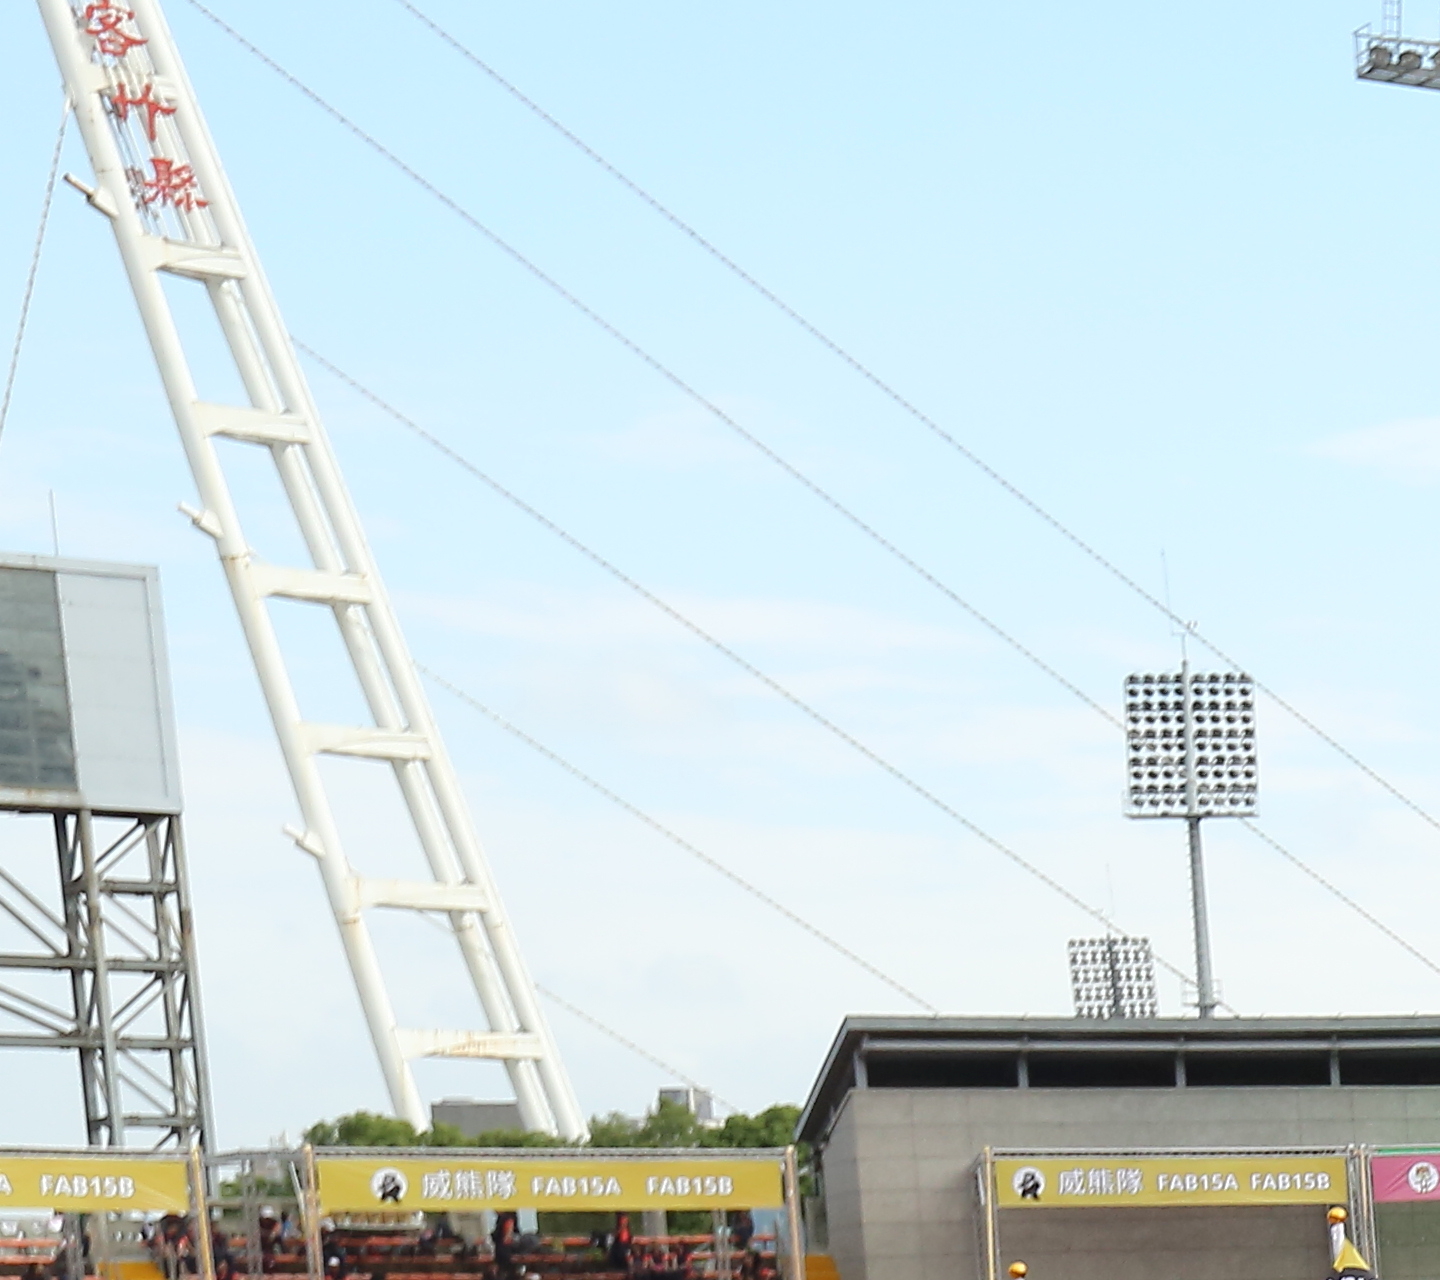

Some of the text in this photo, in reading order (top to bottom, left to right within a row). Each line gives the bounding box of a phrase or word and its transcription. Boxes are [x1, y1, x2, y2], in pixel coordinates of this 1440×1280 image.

[40, 1174, 136, 1198] FAB15B
[421, 1169, 734, 1200] 威熊隊 FAB15A FAB15B
[1058, 1168, 1331, 1195] 威熊隊 FAB15A FAB15B
